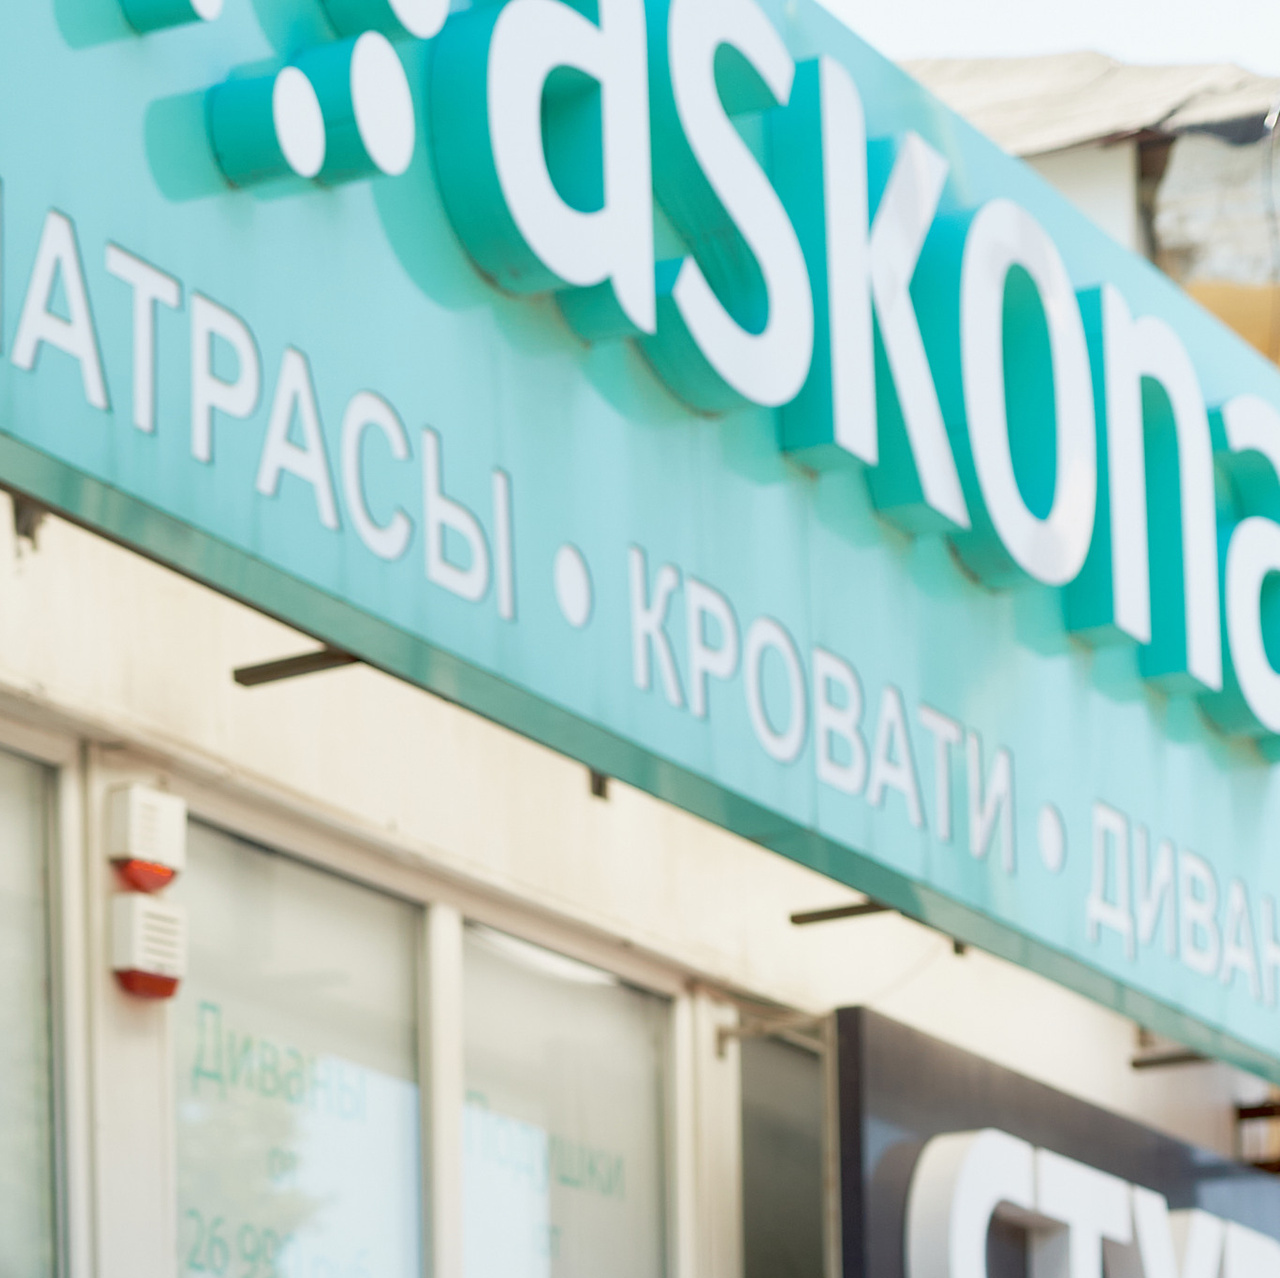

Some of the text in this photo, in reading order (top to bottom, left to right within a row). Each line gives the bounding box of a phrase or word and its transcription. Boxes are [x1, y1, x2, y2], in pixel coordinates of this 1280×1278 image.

[629, 542, 1016, 876] КРОВАТИ
[190, 999, 366, 1123] Диваны
[185, 1207, 230, 1278] 26
